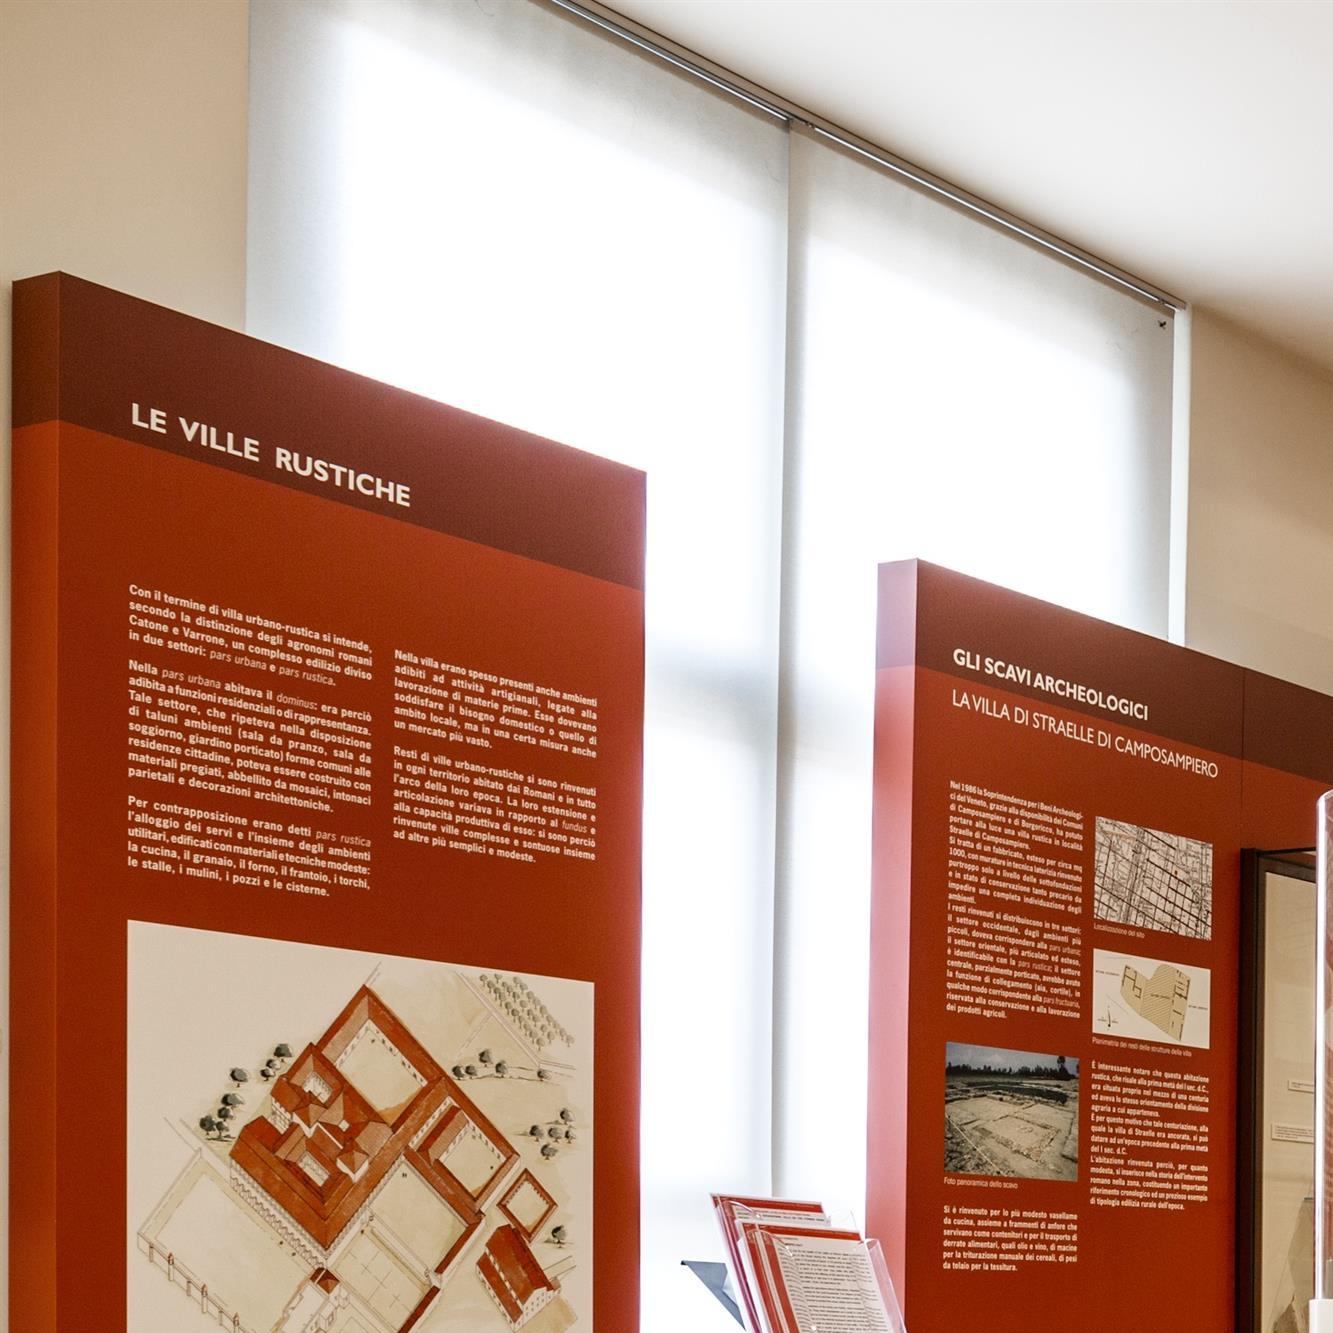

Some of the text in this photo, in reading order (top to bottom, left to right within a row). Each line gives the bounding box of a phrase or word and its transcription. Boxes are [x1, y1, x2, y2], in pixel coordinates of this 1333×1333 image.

[132, 402, 410, 507] LE VILLE RUSTICHE
[128, 614, 372, 680] Catone e Varrone, un complesso edilizio diviso
[129, 584, 372, 653] Con il termine di villa urbano-rustica si intende,
[129, 601, 372, 666] secondo la distinzione degli agronomi romani
[394, 649, 597, 707] Nella villa erano spesso presenti anche ambienti
[394, 665, 597, 720] adibiti ad attività artigianali, legate alla
[953, 648, 1148, 720] GLI SCAVI ARCHEOLOGICI
[952, 688, 1218, 778] LA VILLA DI STRAELLE DI CAMPOSAMPIERO
[393, 745, 596, 796] Resti di ville urbano-rustiche si sono rinvenuti
